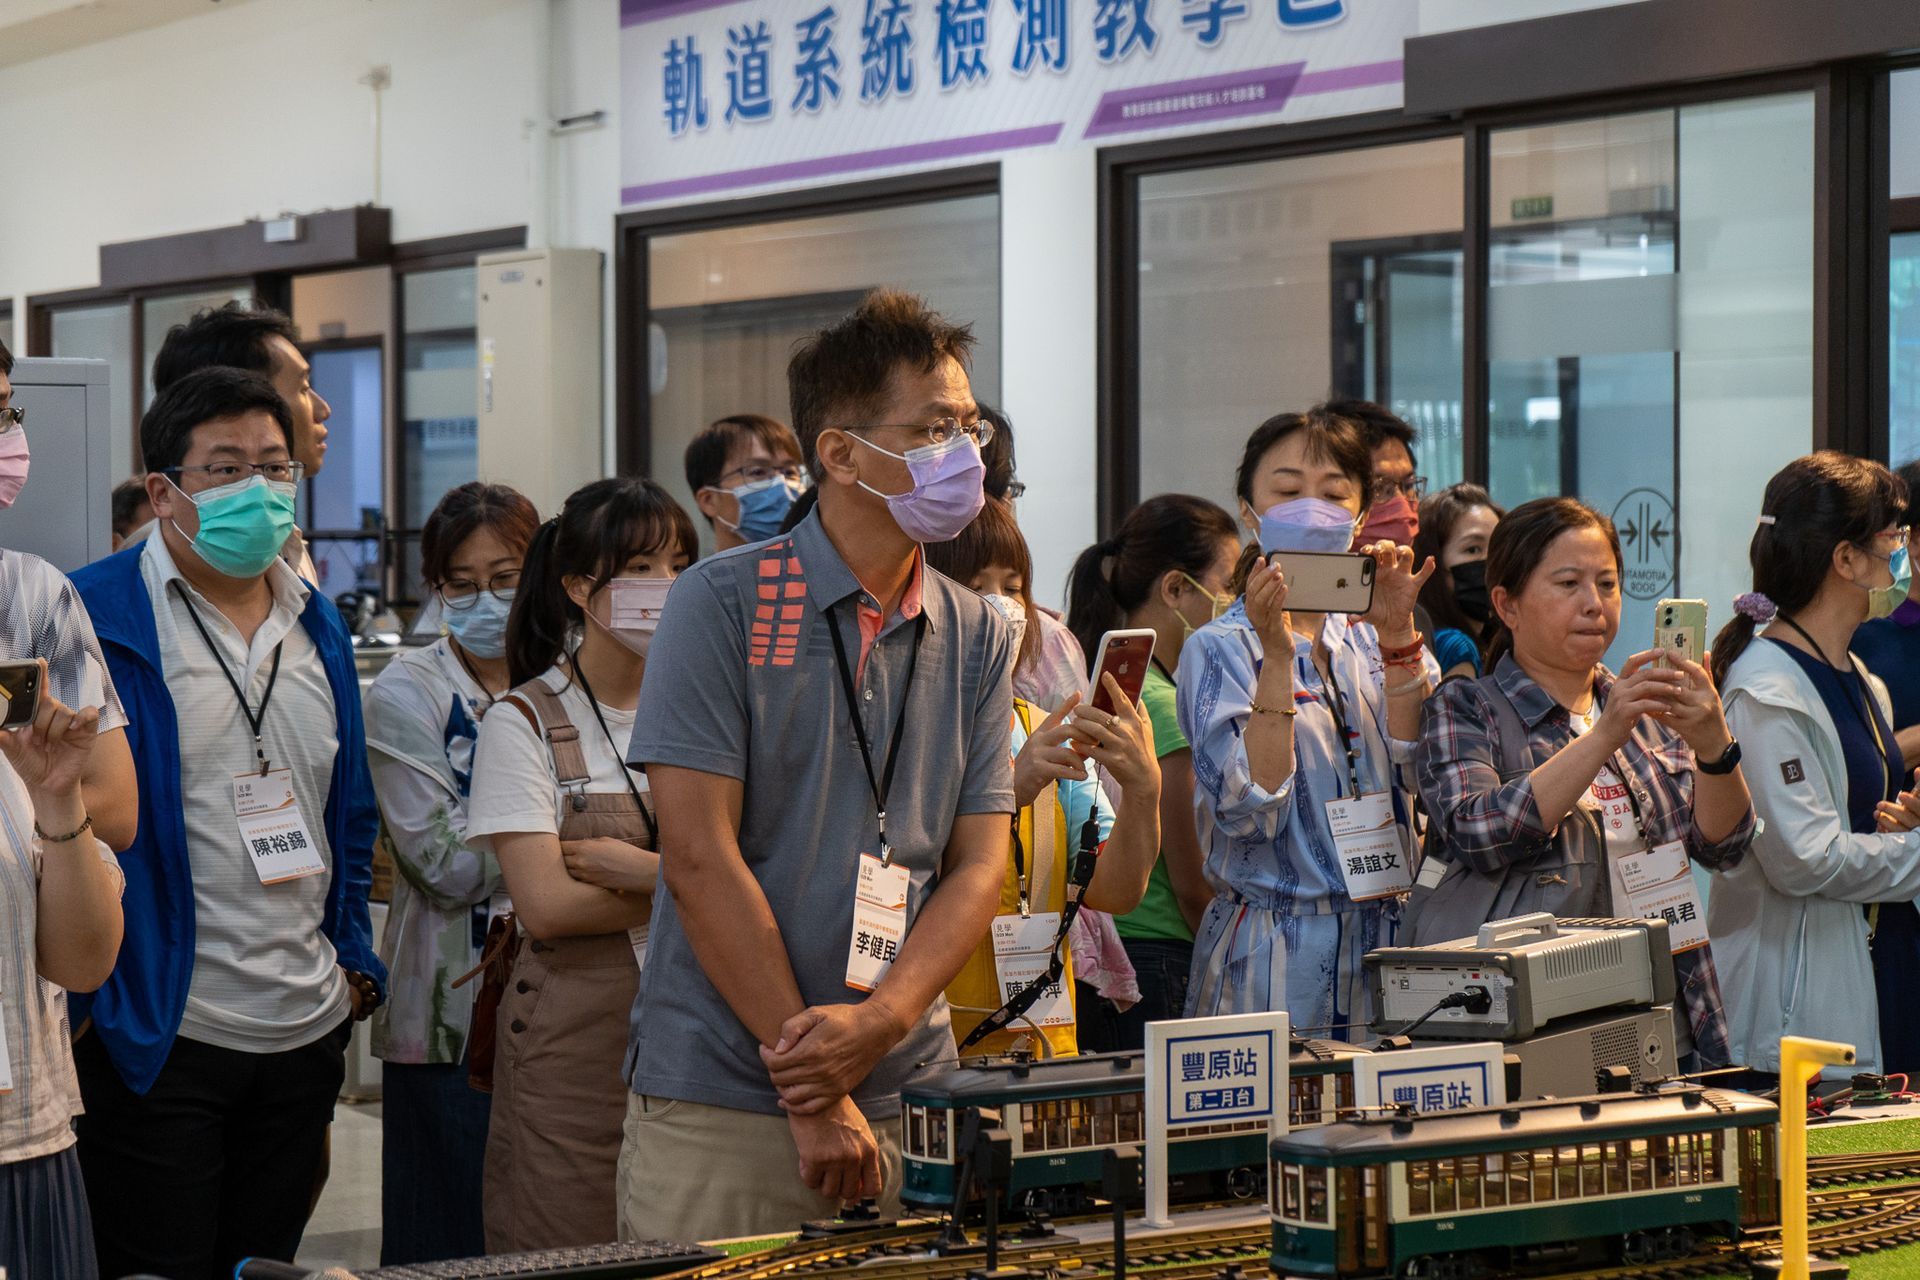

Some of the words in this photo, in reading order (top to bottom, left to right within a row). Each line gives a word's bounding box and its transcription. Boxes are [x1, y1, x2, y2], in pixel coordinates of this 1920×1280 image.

[663, 0, 1343, 134] 軌道系統檢測教
[251, 830, 307, 858] 陳裕錫
[1346, 851, 1401, 876] 湯誼文
[855, 931, 897, 964] 李健民
[1181, 1047, 1258, 1083] 豐原站
[1188, 1087, 1251, 1111] 第二月台
[1393, 1081, 1472, 1112] 豐原站
